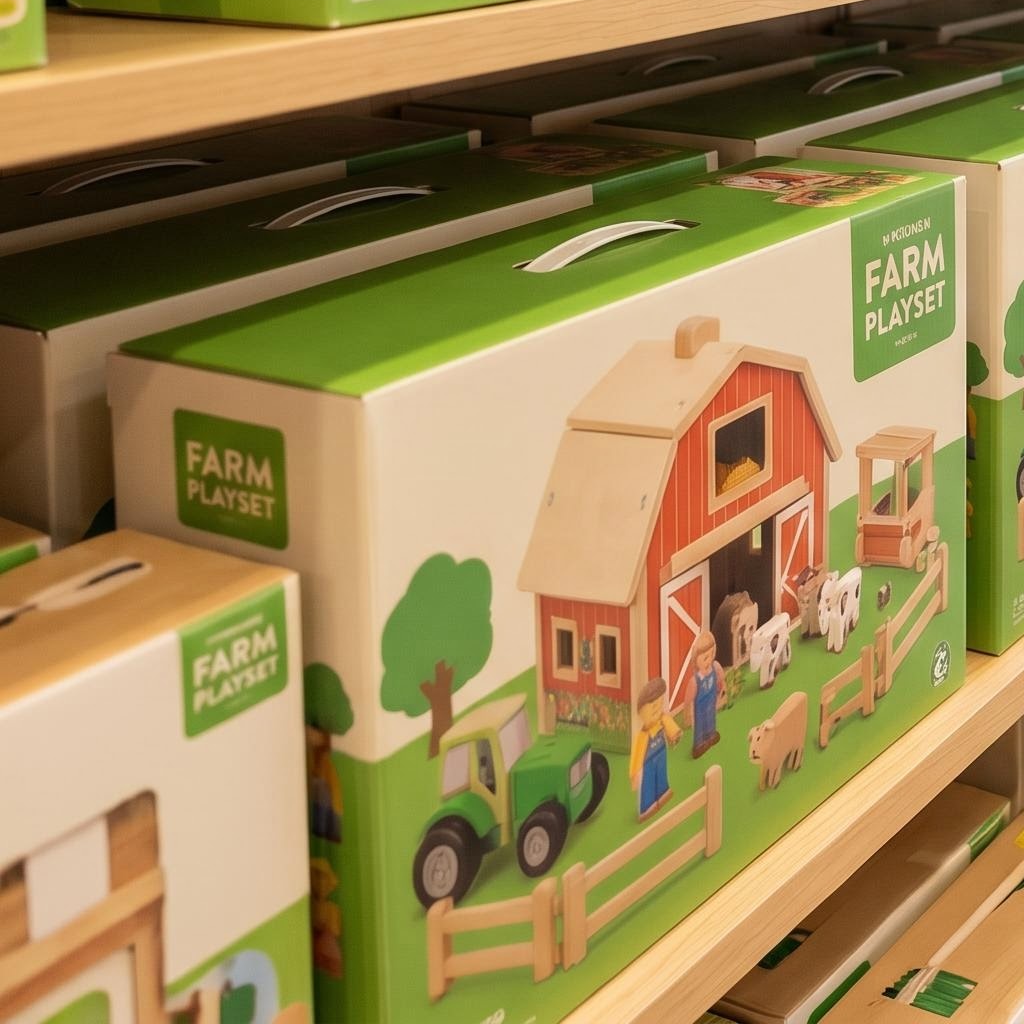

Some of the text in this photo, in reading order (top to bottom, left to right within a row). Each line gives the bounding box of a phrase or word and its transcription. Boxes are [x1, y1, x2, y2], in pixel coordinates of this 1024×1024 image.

[865, 233, 945, 305] FARM
[865, 279, 946, 342] PLAYSET
[186, 440, 273, 491] FARM
[187, 478, 275, 520] PLAYSET
[193, 622, 278, 688] FARM
[193, 654, 279, 715] PLAYSET
